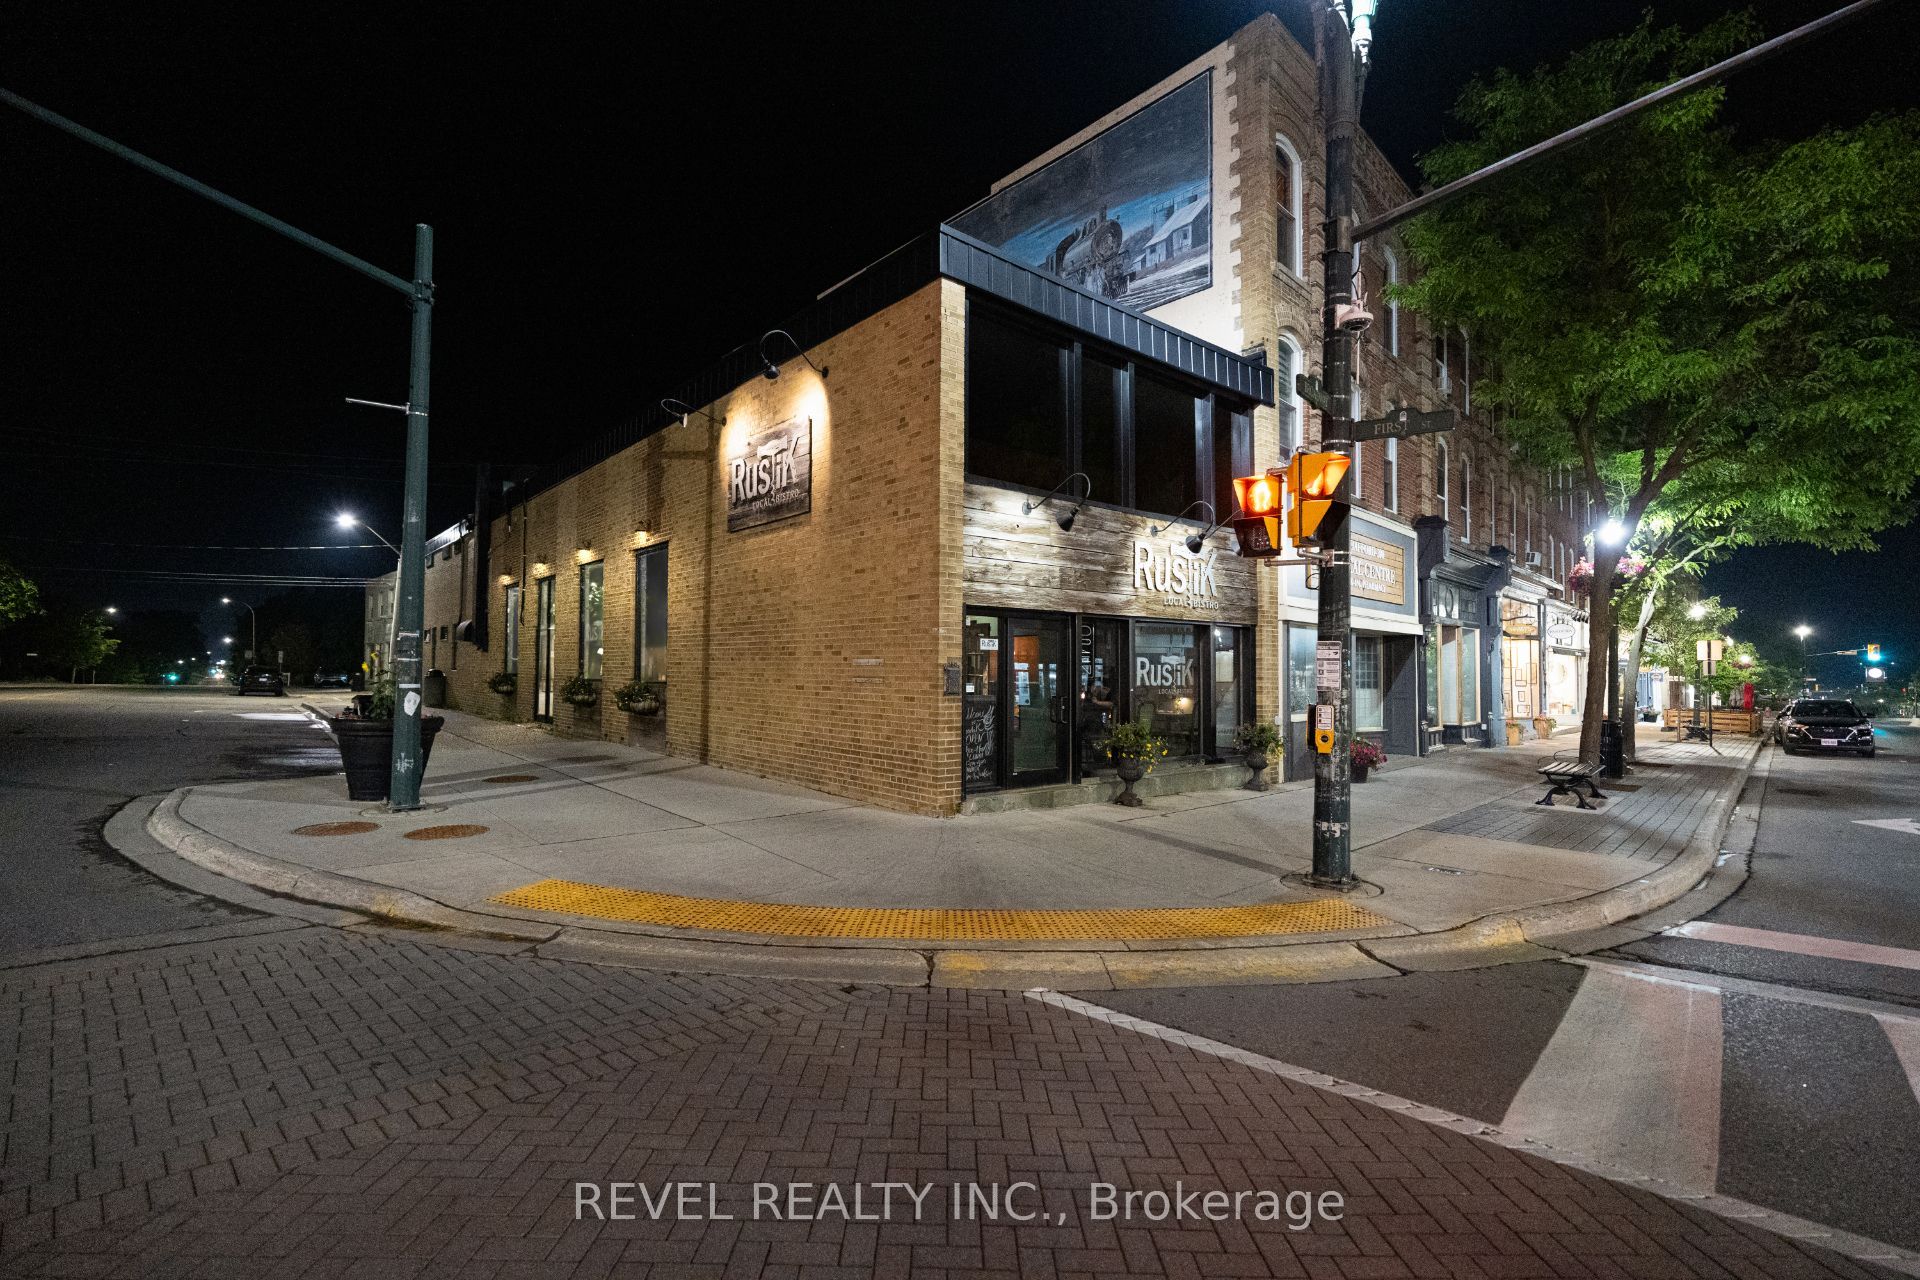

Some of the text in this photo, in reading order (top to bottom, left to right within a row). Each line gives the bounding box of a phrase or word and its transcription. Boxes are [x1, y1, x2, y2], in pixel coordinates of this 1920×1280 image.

[1374, 421, 1408, 435] FIRST
[752, 488, 800, 511] LOCAL BISTRO
[1364, 562, 1397, 585] CENTRE
[1164, 596, 1219, 610] LOCAL BISTRO
